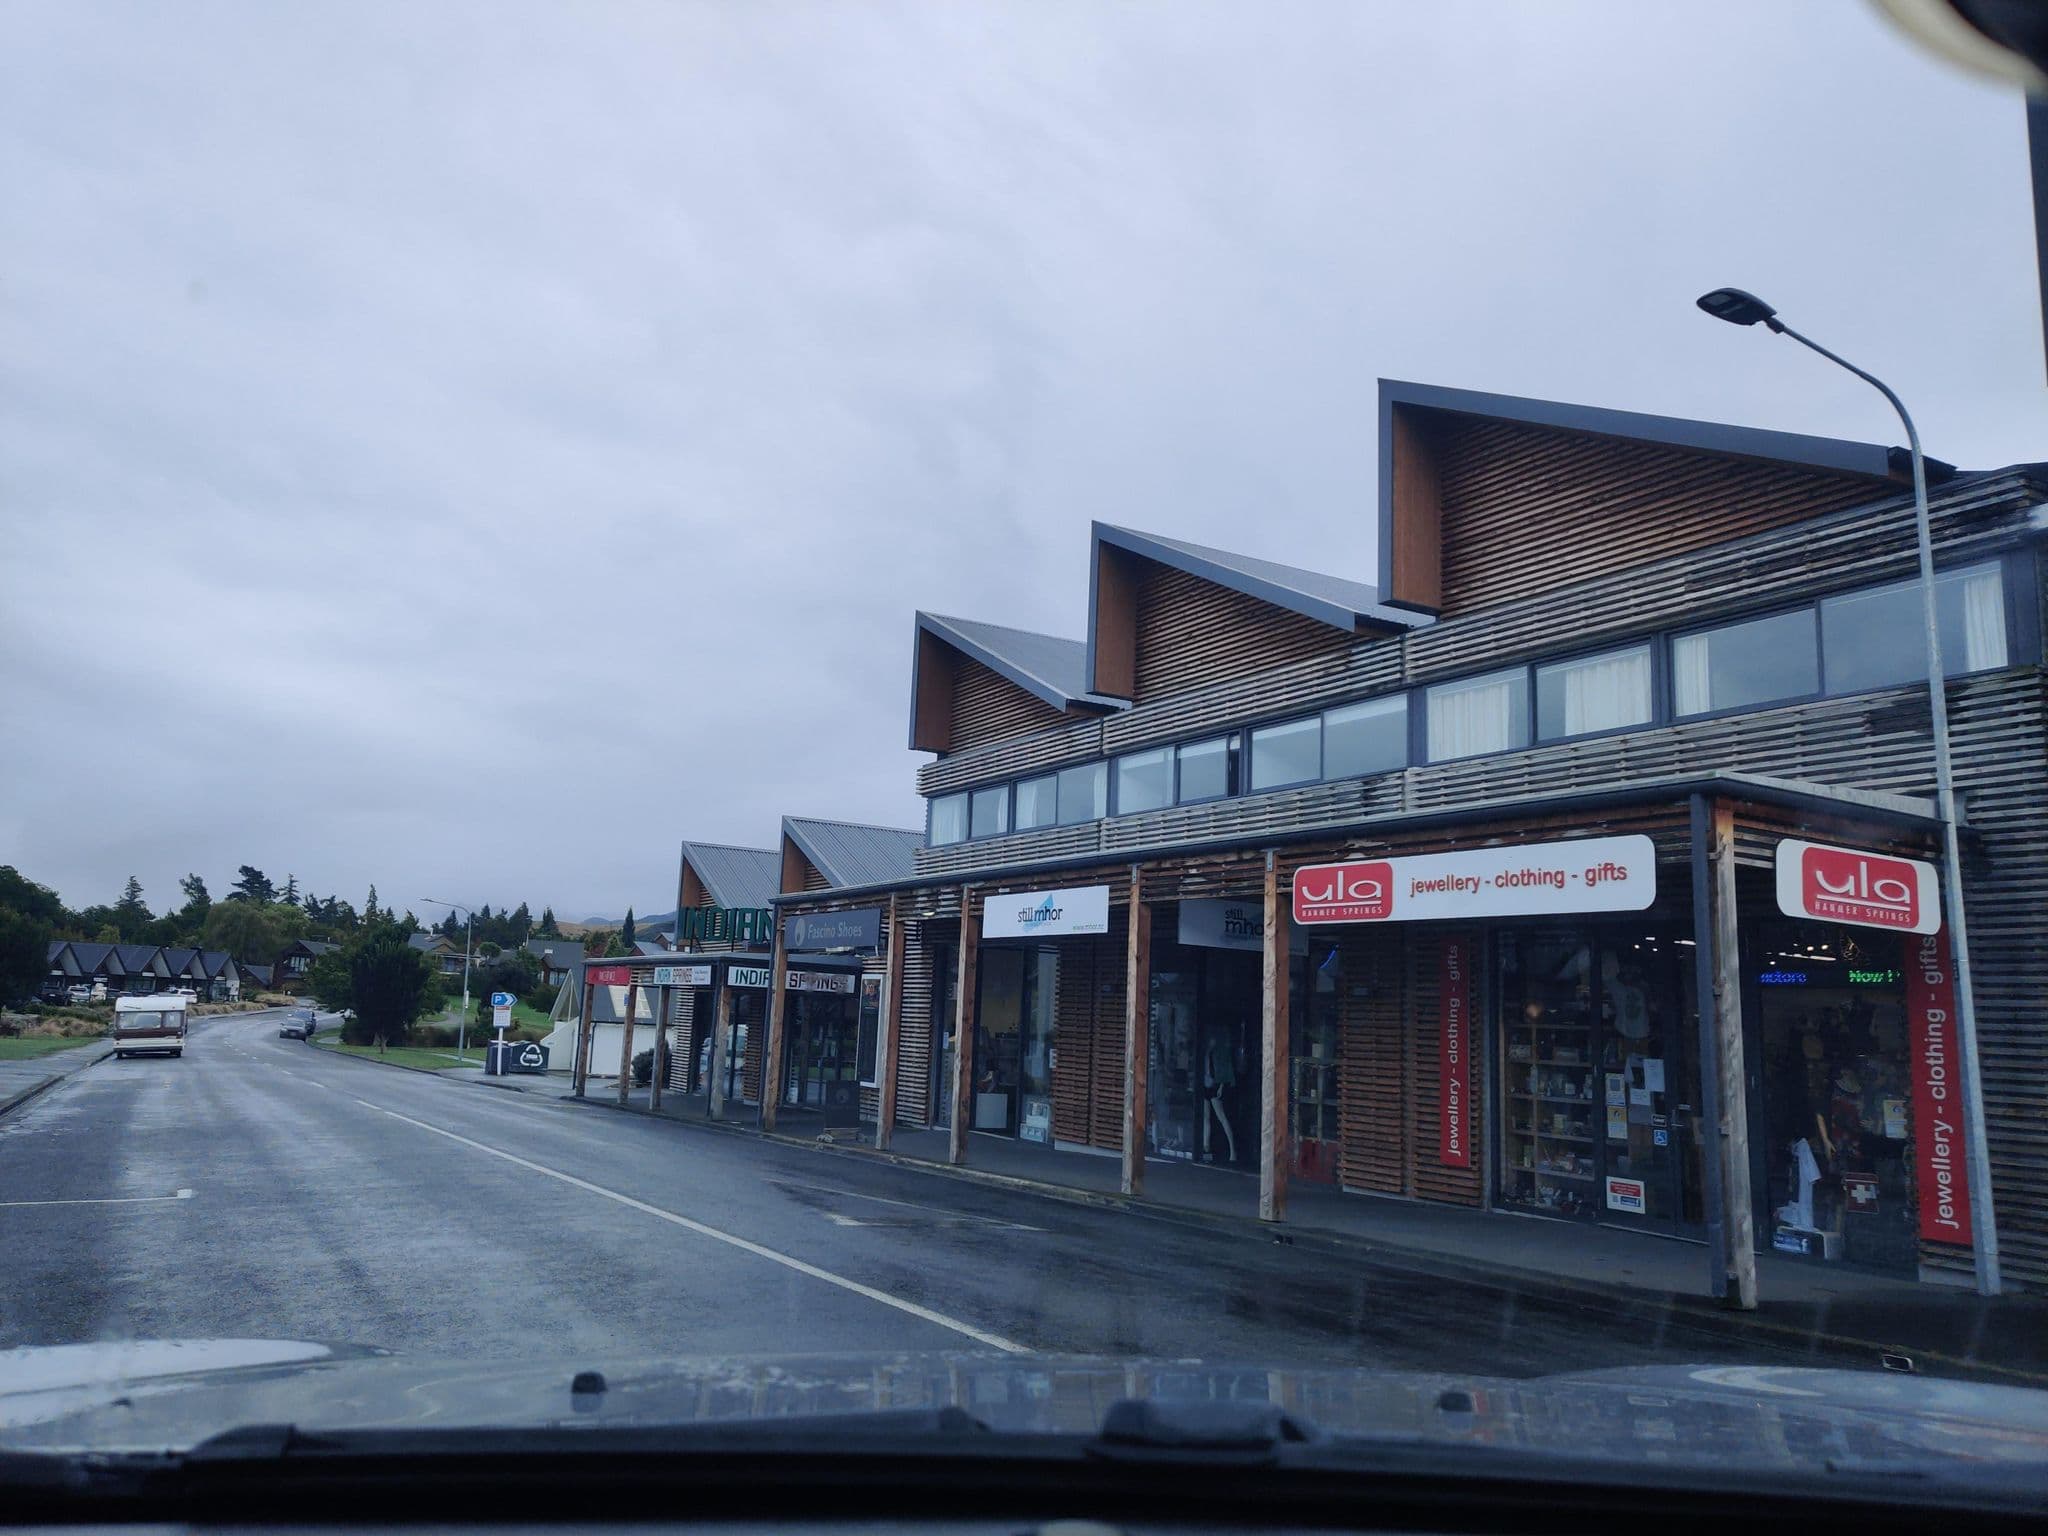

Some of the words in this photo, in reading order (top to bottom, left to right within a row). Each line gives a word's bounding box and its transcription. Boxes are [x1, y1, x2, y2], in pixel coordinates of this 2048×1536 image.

[1301, 870, 1382, 902] ula
[1410, 875, 1481, 898] jewellery
[1495, 867, 1565, 889] clothing
[1585, 862, 1628, 888] gifts
[1815, 861, 1911, 904] ula
[1017, 907, 1033, 923] still
[1034, 906, 1064, 922] mhor
[1224, 907, 1244, 921] still
[1224, 917, 1265, 937] mho
[1343, 906, 1383, 916] SPRINGS
[1814, 901, 1858, 916] HANMER
[1865, 908, 1911, 923] SPRINGS
[808, 923, 836, 940] Fascino
[837, 921, 864, 937] Shoes
[1447, 944, 1461, 981] gifts
[1920, 936, 1943, 985] gifts
[494, 995, 502, 1004] P
[1447, 997, 1462, 1064] clothing
[1924, 1008, 1947, 1100] clothing
[1447, 1077, 1462, 1157] jewellery
[1932, 1119, 1960, 1230] jewellery
